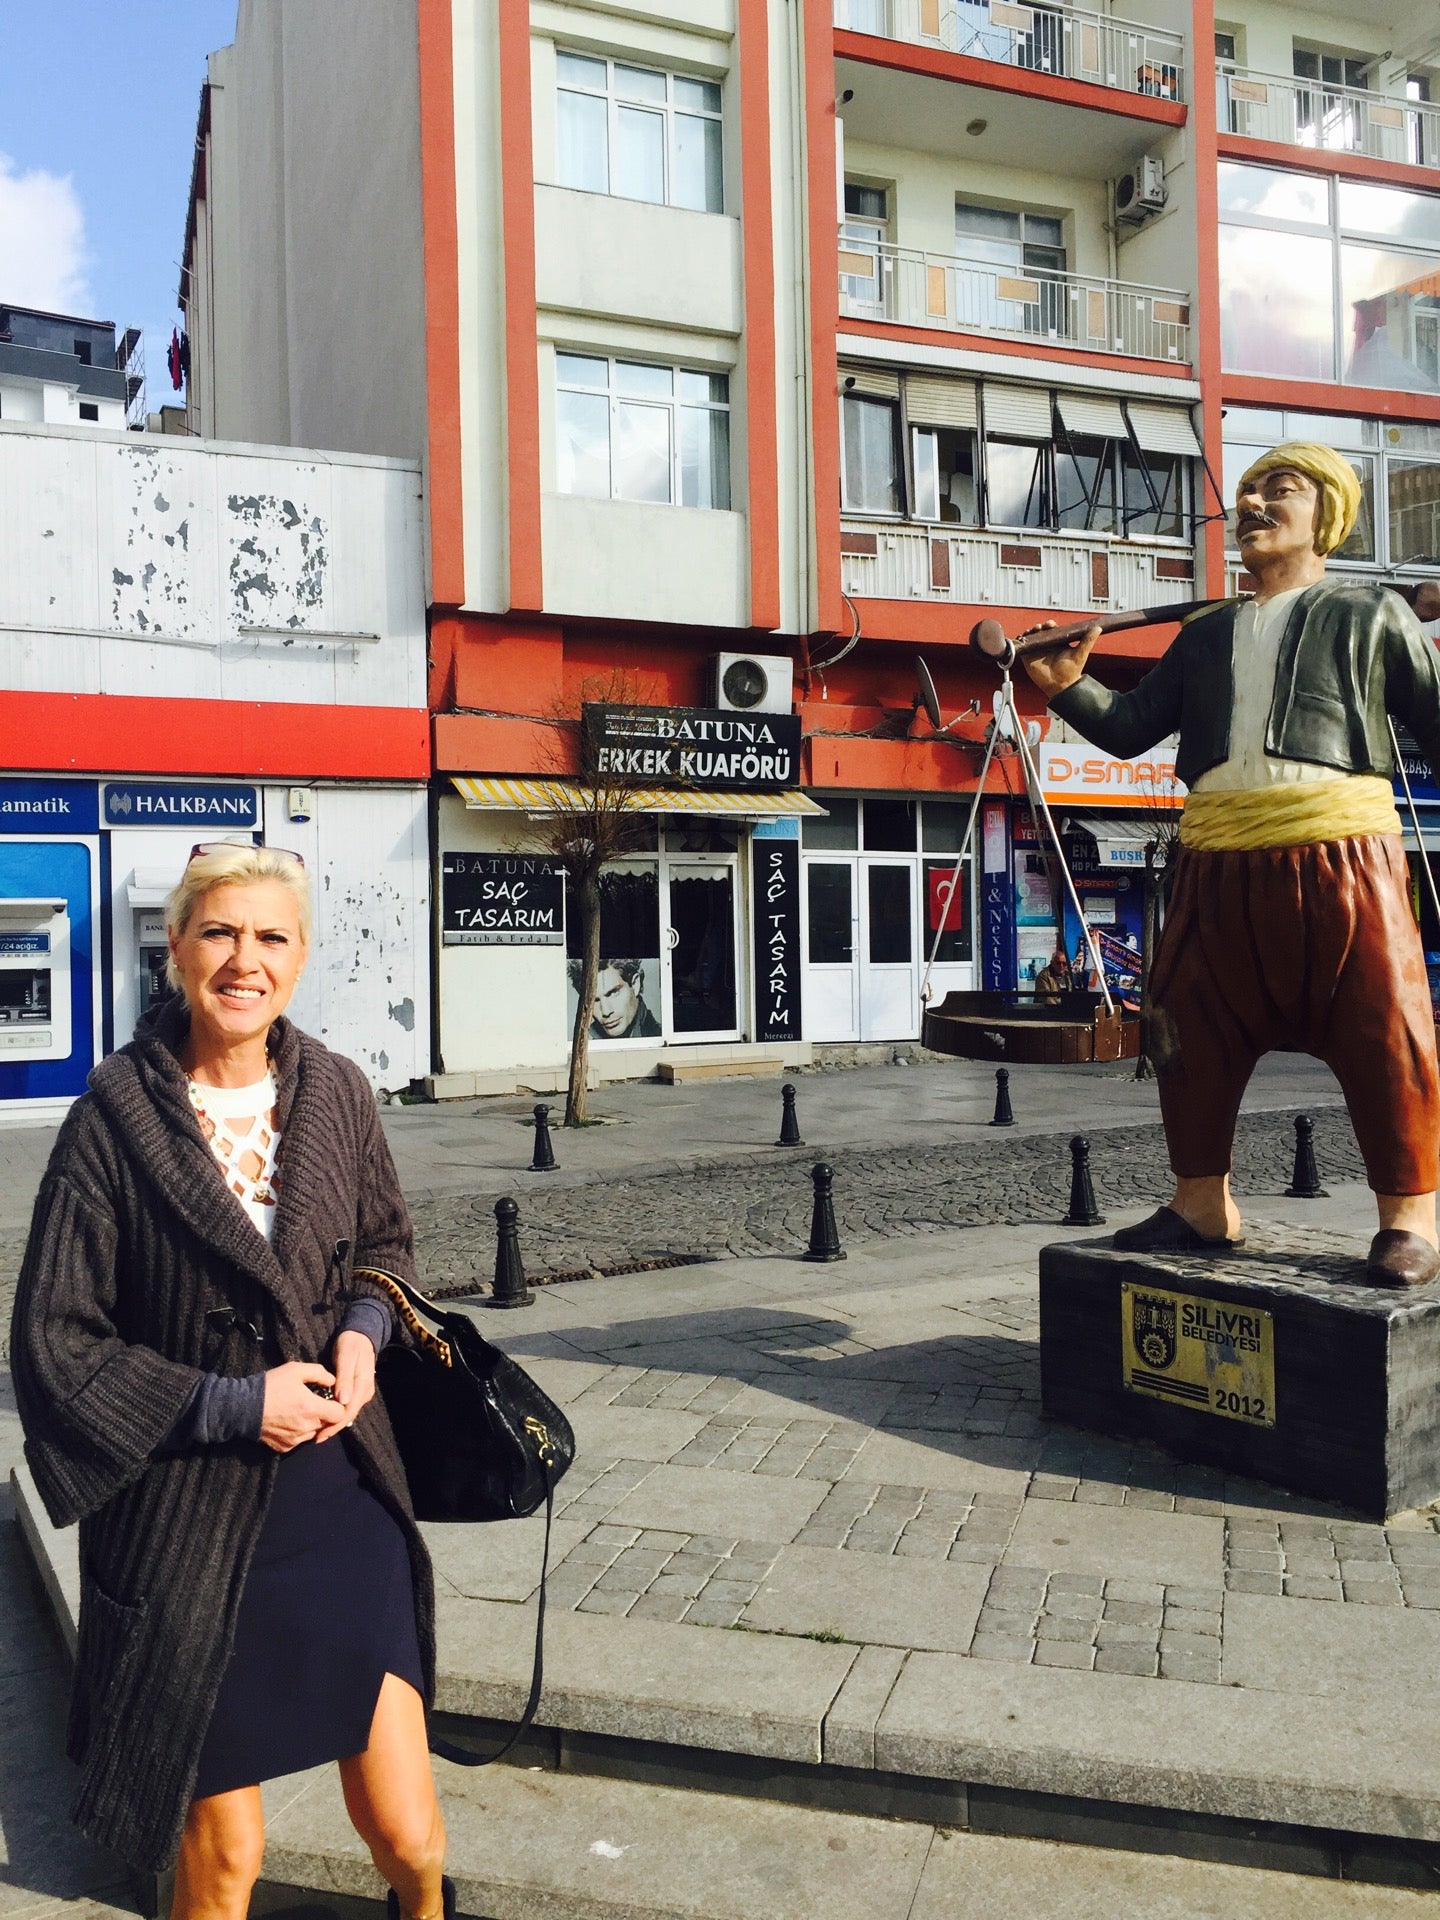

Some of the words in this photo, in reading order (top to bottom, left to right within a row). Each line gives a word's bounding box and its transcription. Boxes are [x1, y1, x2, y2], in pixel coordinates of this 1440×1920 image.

[656, 717, 776, 744] BATUNA
[598, 747, 672, 775] ERKEK
[679, 746, 790, 780] KUAFÖRÜ
[1393, 759, 1432, 779] ZBAŞ
[0, 797, 71, 813] amatik
[136, 796, 252, 814] HALKBANK
[455, 859, 553, 875] BATUNA
[766, 852, 786, 903] SAÇ
[482, 881, 528, 905] SAÇ
[988, 888, 1002, 903] &
[455, 908, 553, 928] TASARIM
[0, 942, 14, 950] /24
[460, 934, 490, 943] Fatih
[496, 935, 504, 943] &
[510, 935, 549, 943] Erdal
[768, 914, 789, 1025] TASARIM
[1182, 1324, 1261, 1353] BELEDİYESİ
[1215, 1389, 1266, 1420] 2012
